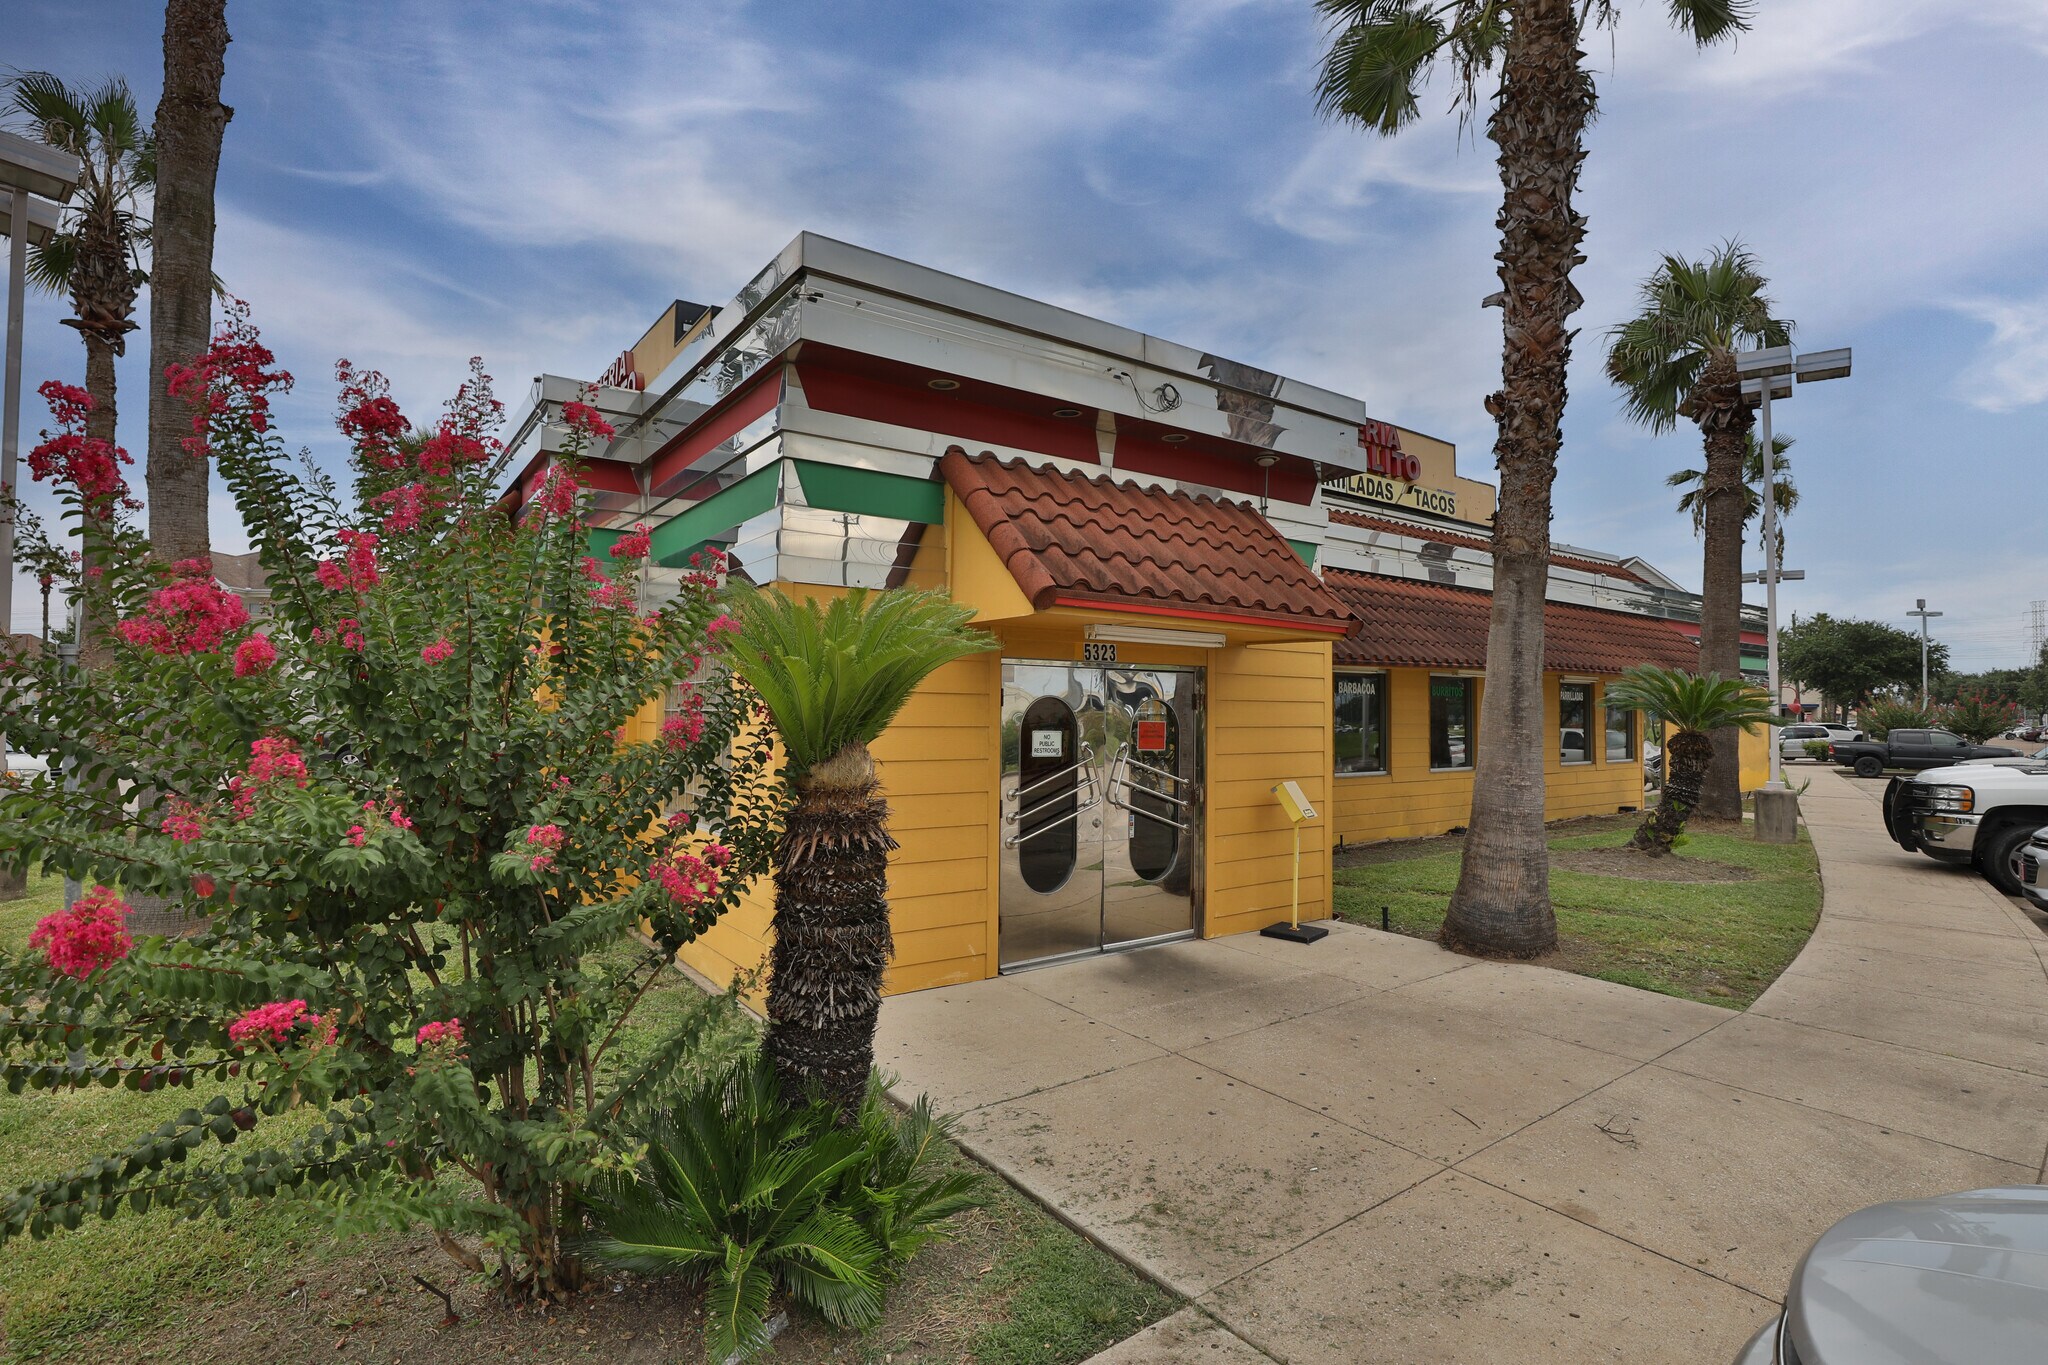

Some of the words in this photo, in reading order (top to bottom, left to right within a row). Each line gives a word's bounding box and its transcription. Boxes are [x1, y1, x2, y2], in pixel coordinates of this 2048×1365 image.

[1414, 488, 1455, 515] TACOS
[1084, 643, 1116, 661] 5323
[1338, 681, 1376, 695] BARBACOA
[1431, 685, 1463, 696] BURRITOS
